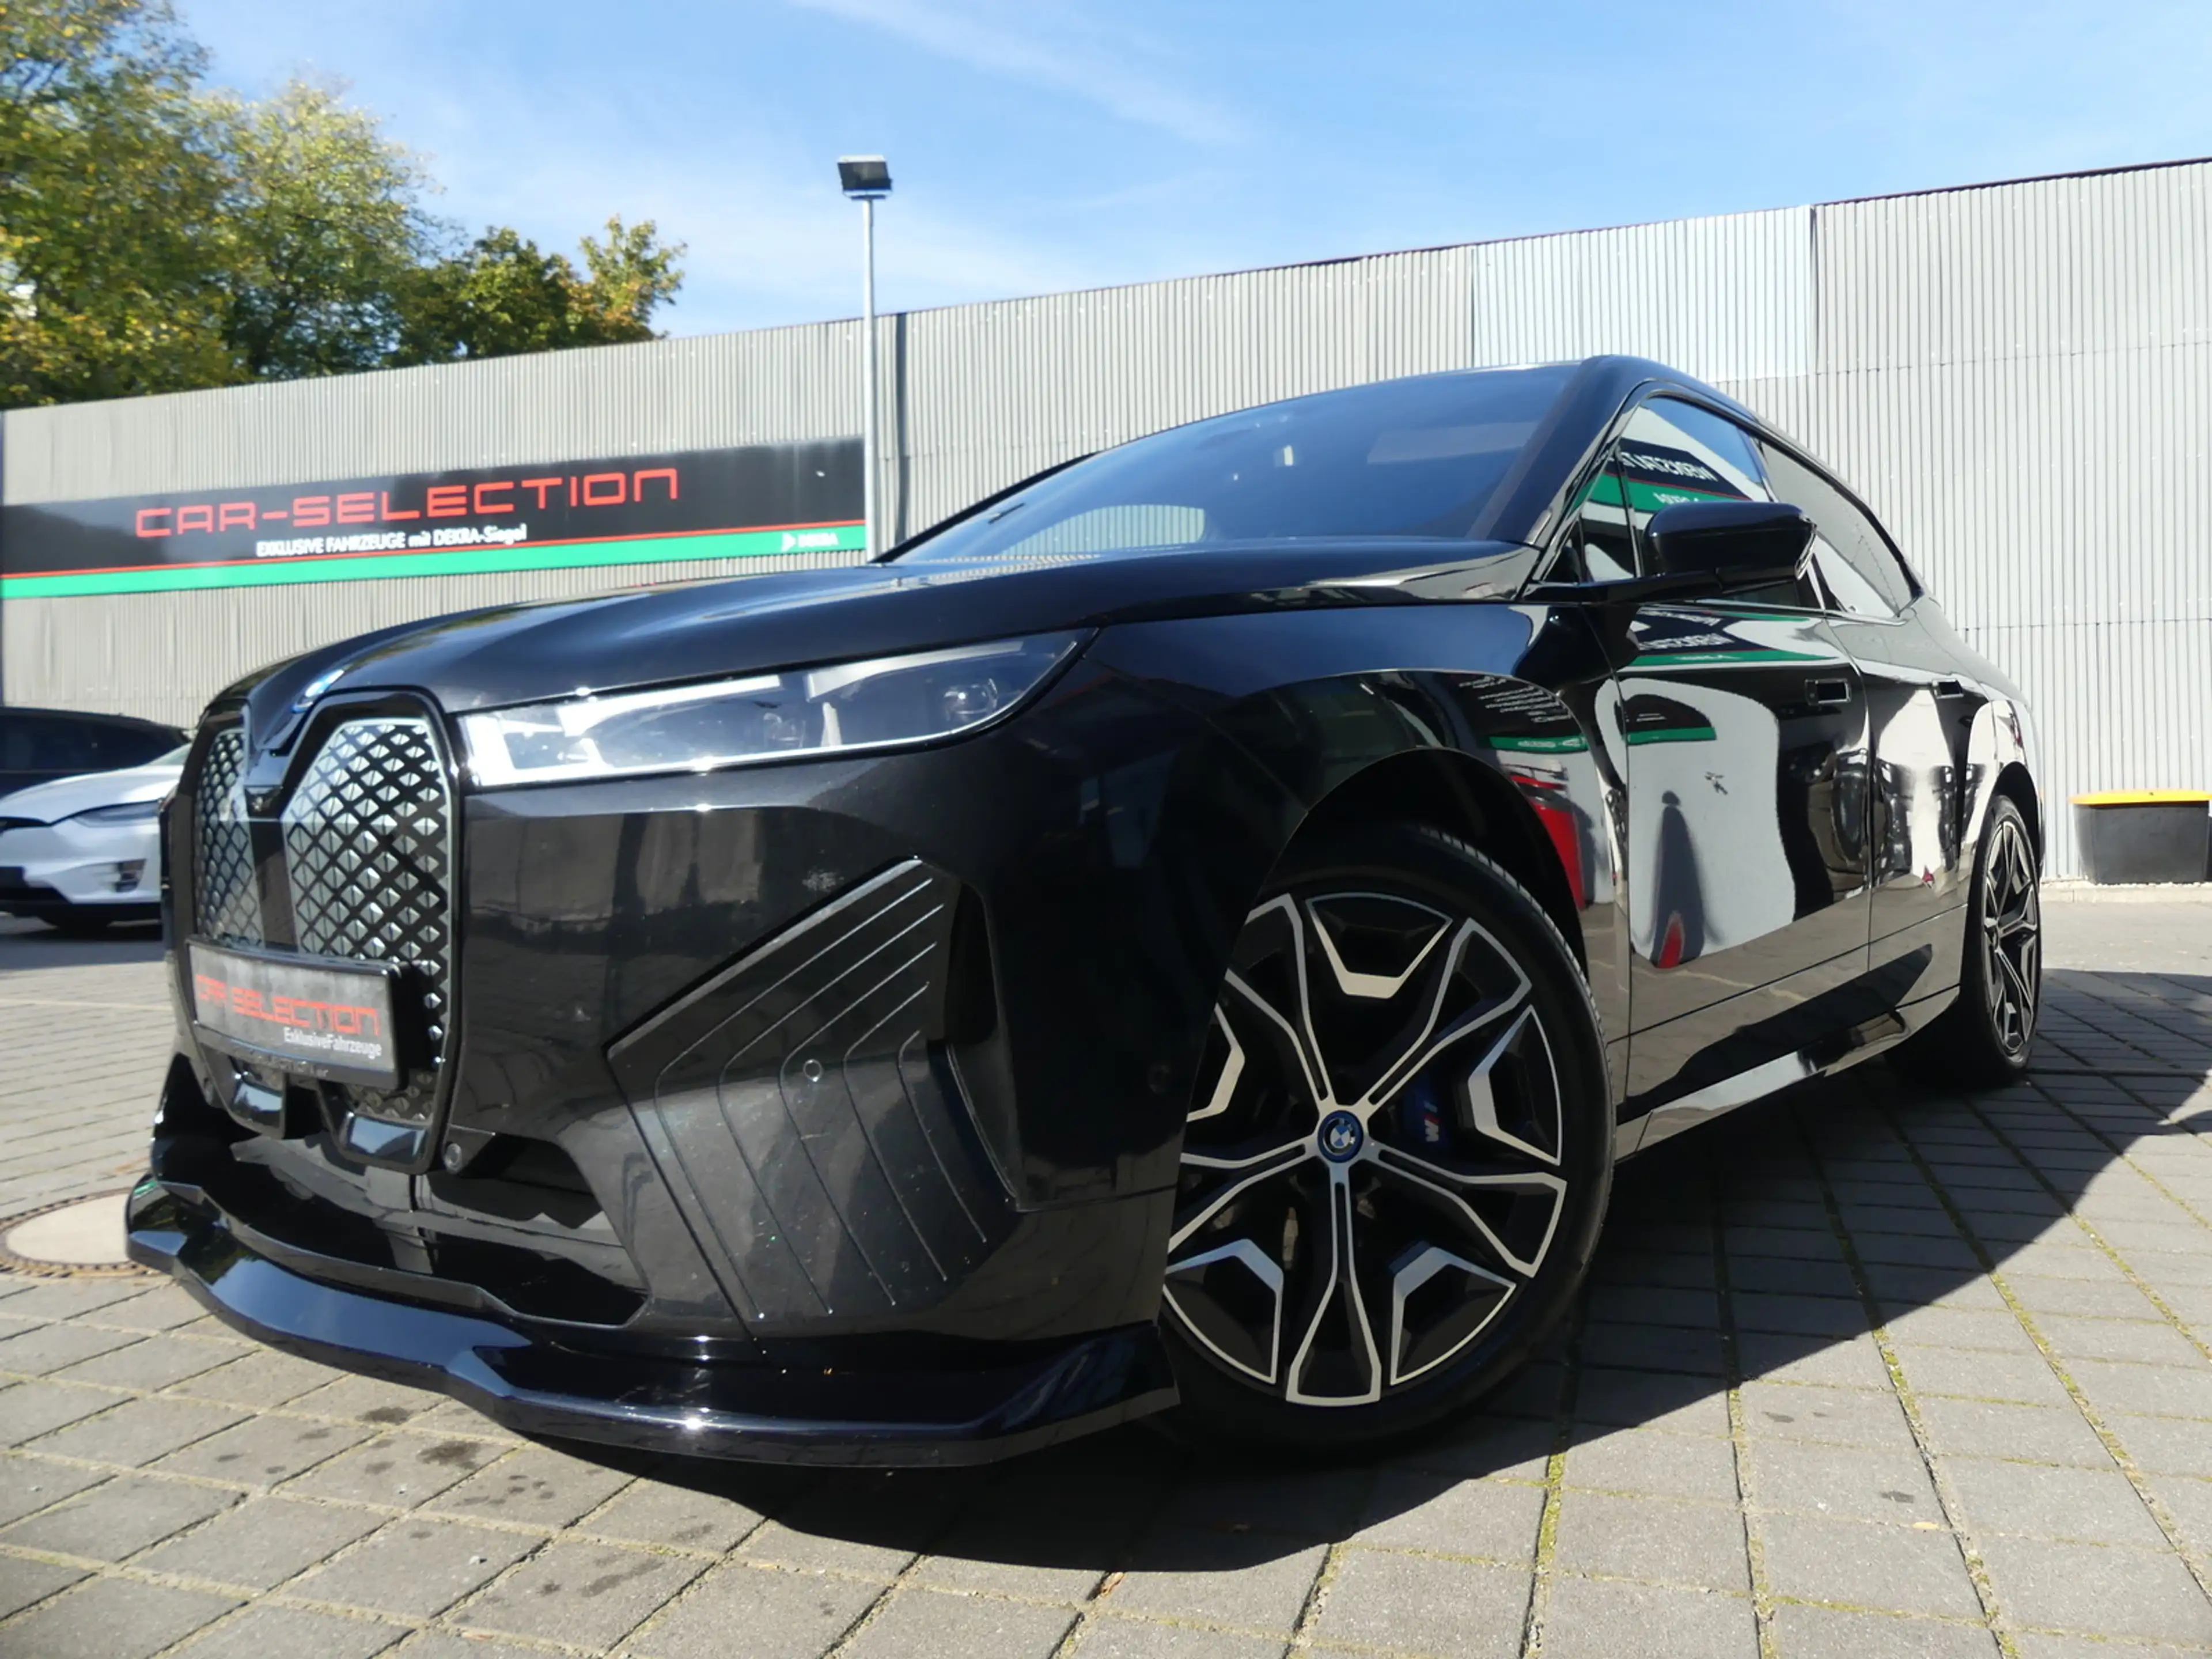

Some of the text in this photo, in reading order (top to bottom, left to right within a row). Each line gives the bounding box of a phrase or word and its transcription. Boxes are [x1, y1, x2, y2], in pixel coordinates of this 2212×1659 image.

[135, 467, 680, 538] CAR-SELECTION
[256, 537, 324, 558] EXKLUSIVE
[325, 532, 406, 553] FAHRZEUGE
[408, 531, 431, 547] mit
[231, 986, 381, 1037] SELECTION
